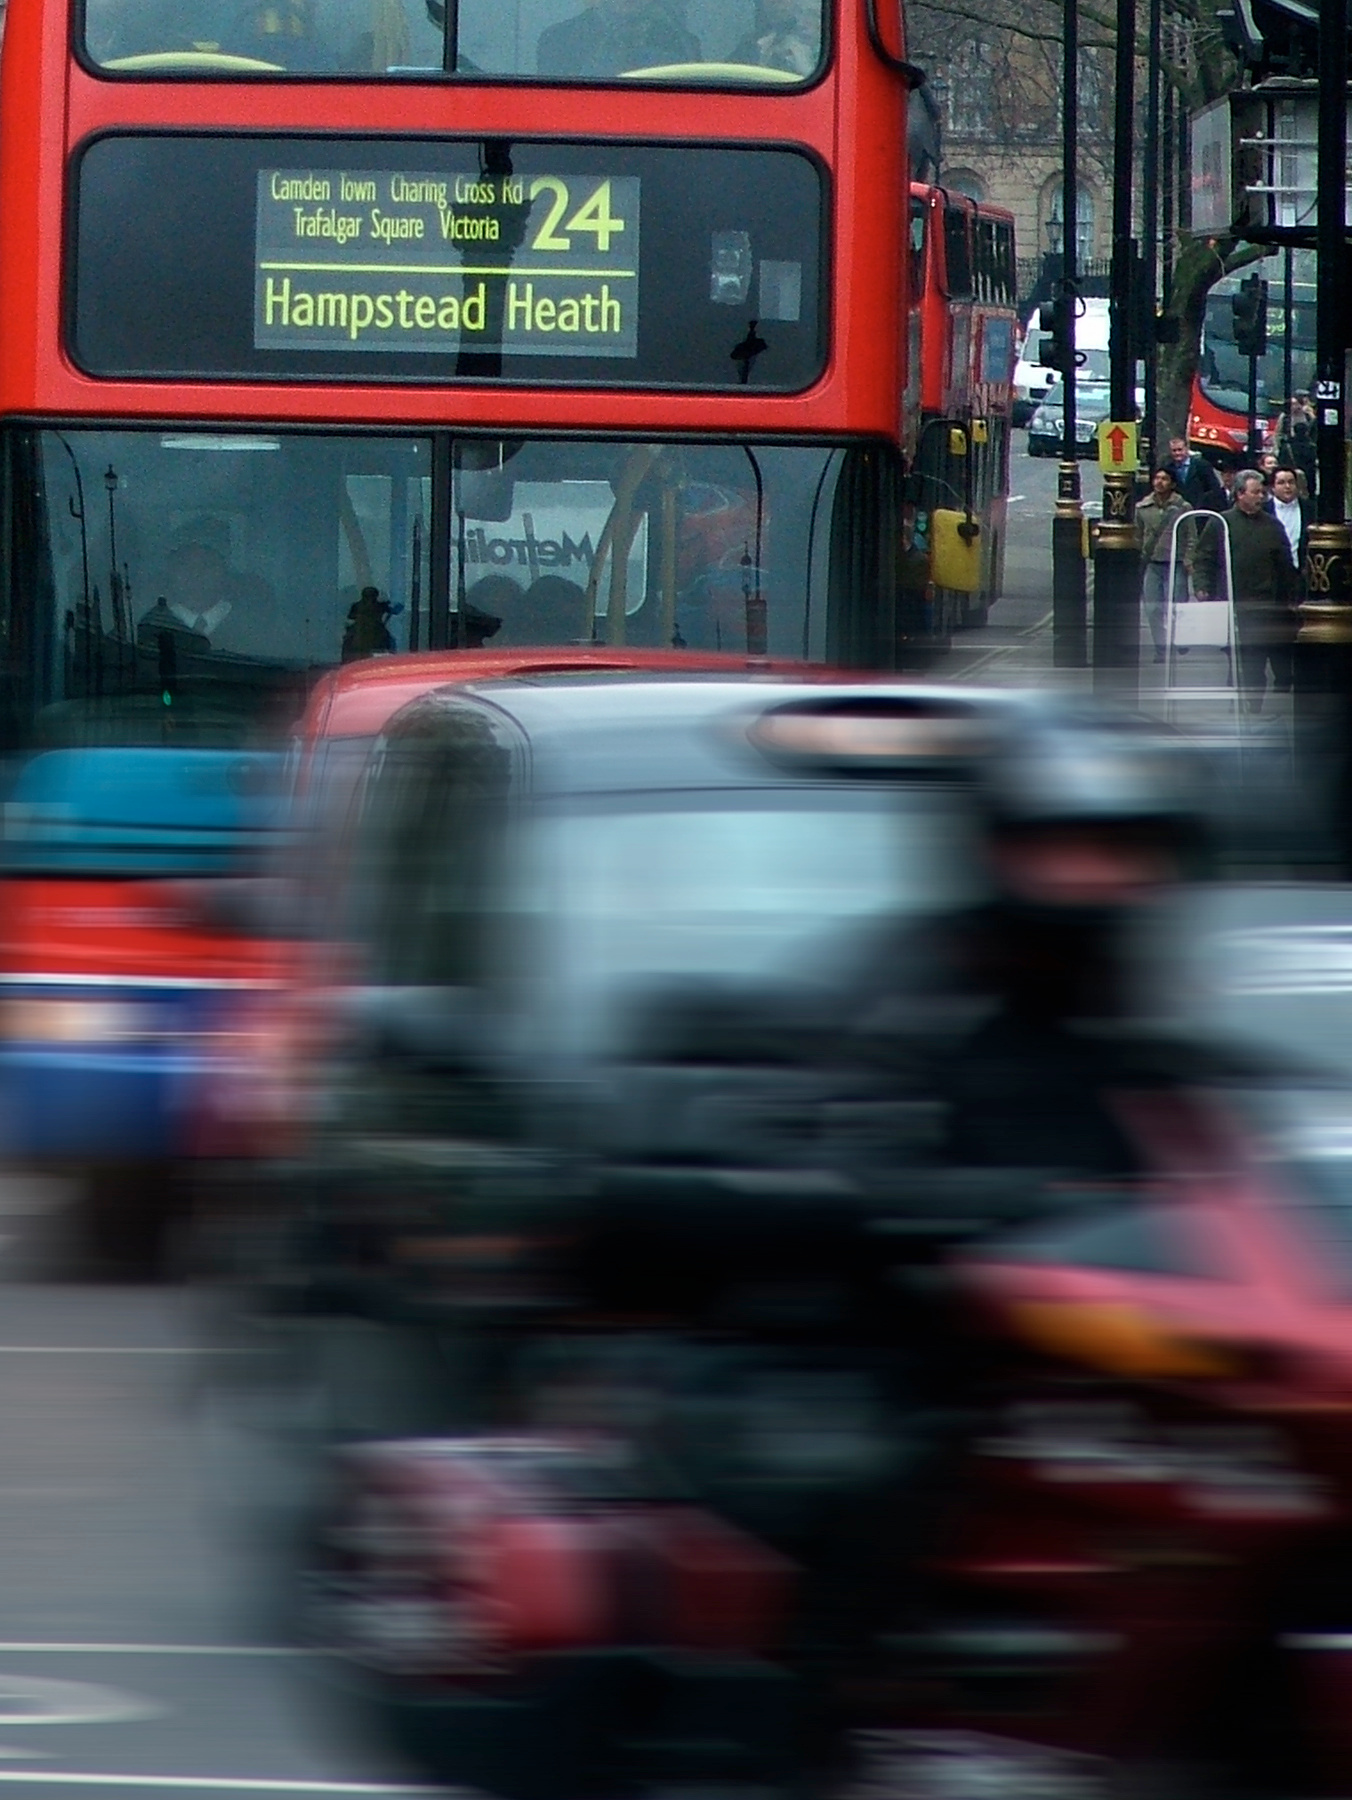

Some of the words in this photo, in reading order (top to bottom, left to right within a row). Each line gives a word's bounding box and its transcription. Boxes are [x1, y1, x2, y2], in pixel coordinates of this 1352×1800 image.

[271, 171, 330, 201] Camden
[340, 173, 376, 201] Town
[391, 174, 447, 207] Charing
[455, 177, 495, 205] Cross
[503, 178, 524, 205] Rd
[530, 176, 625, 252] 24
[293, 207, 362, 244] Trafalgar
[370, 209, 424, 244] Square
[439, 209, 500, 241] Victoria
[264, 277, 486, 340] Hampstead
[508, 282, 621, 333] Heath
